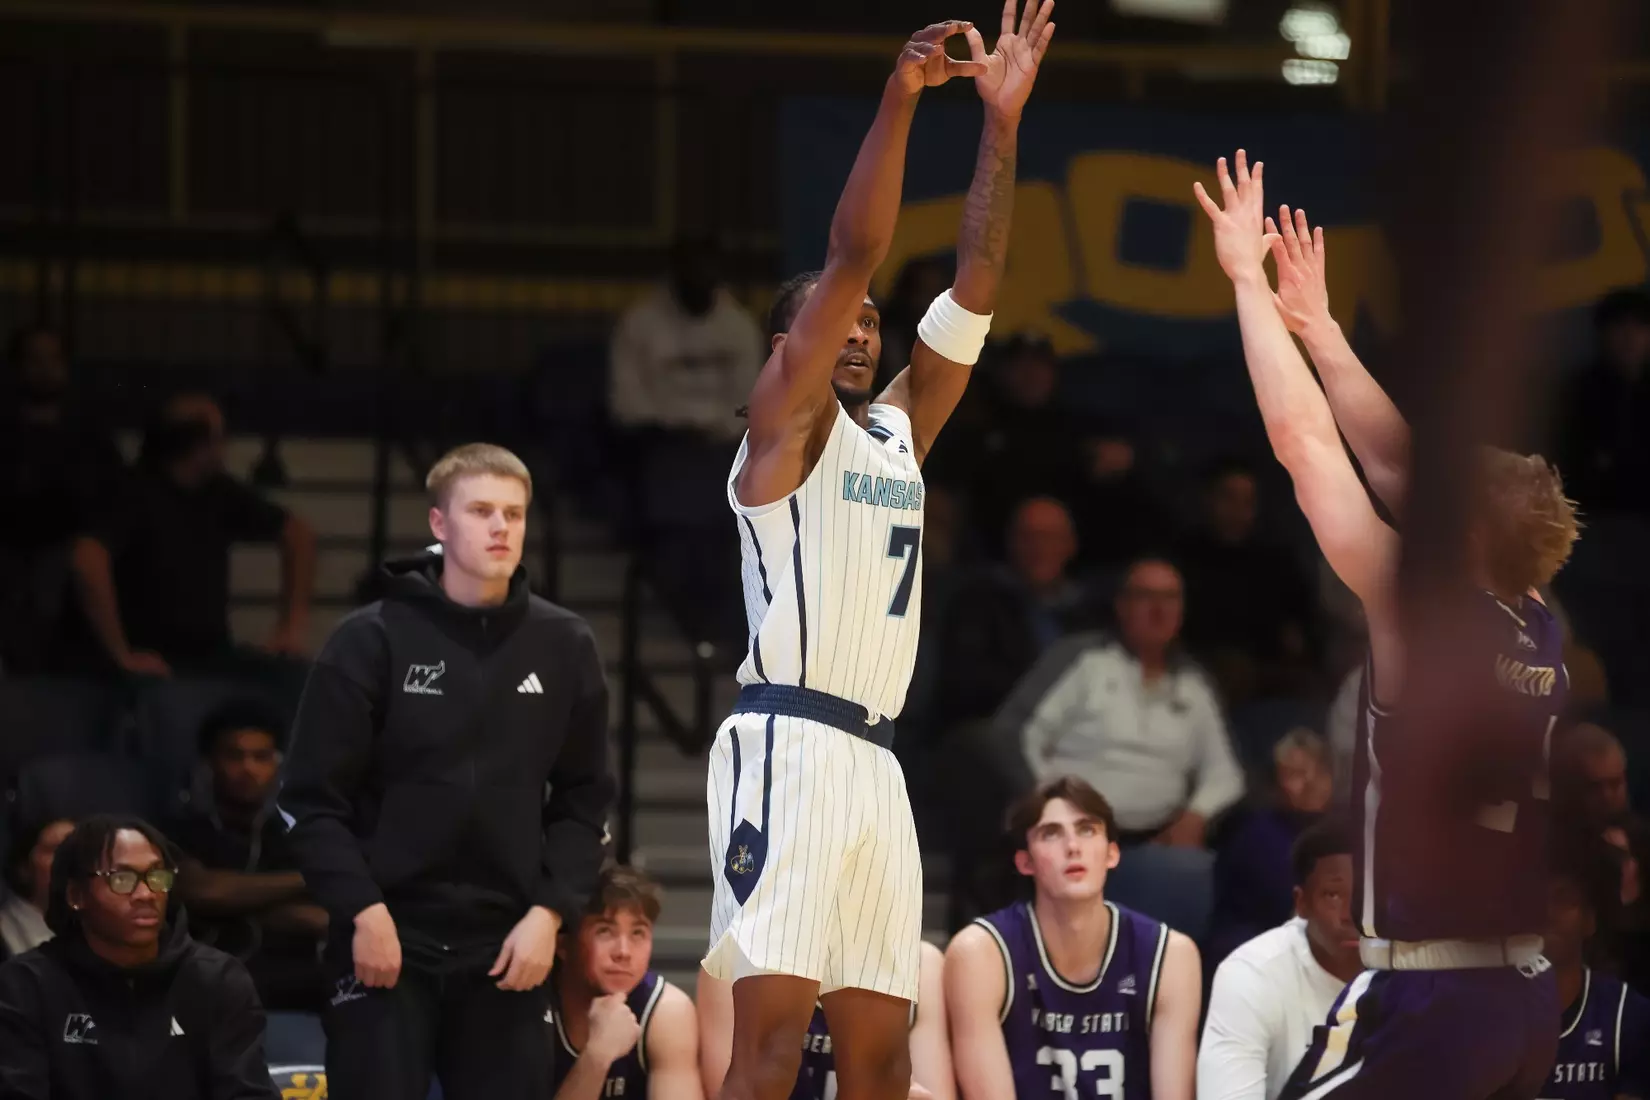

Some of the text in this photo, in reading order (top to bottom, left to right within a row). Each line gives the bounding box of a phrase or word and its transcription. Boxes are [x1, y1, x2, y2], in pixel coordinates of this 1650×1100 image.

[843, 471, 924, 511] KANSAS
[886, 523, 922, 619] 7
[1036, 1046, 1125, 1100] 33
